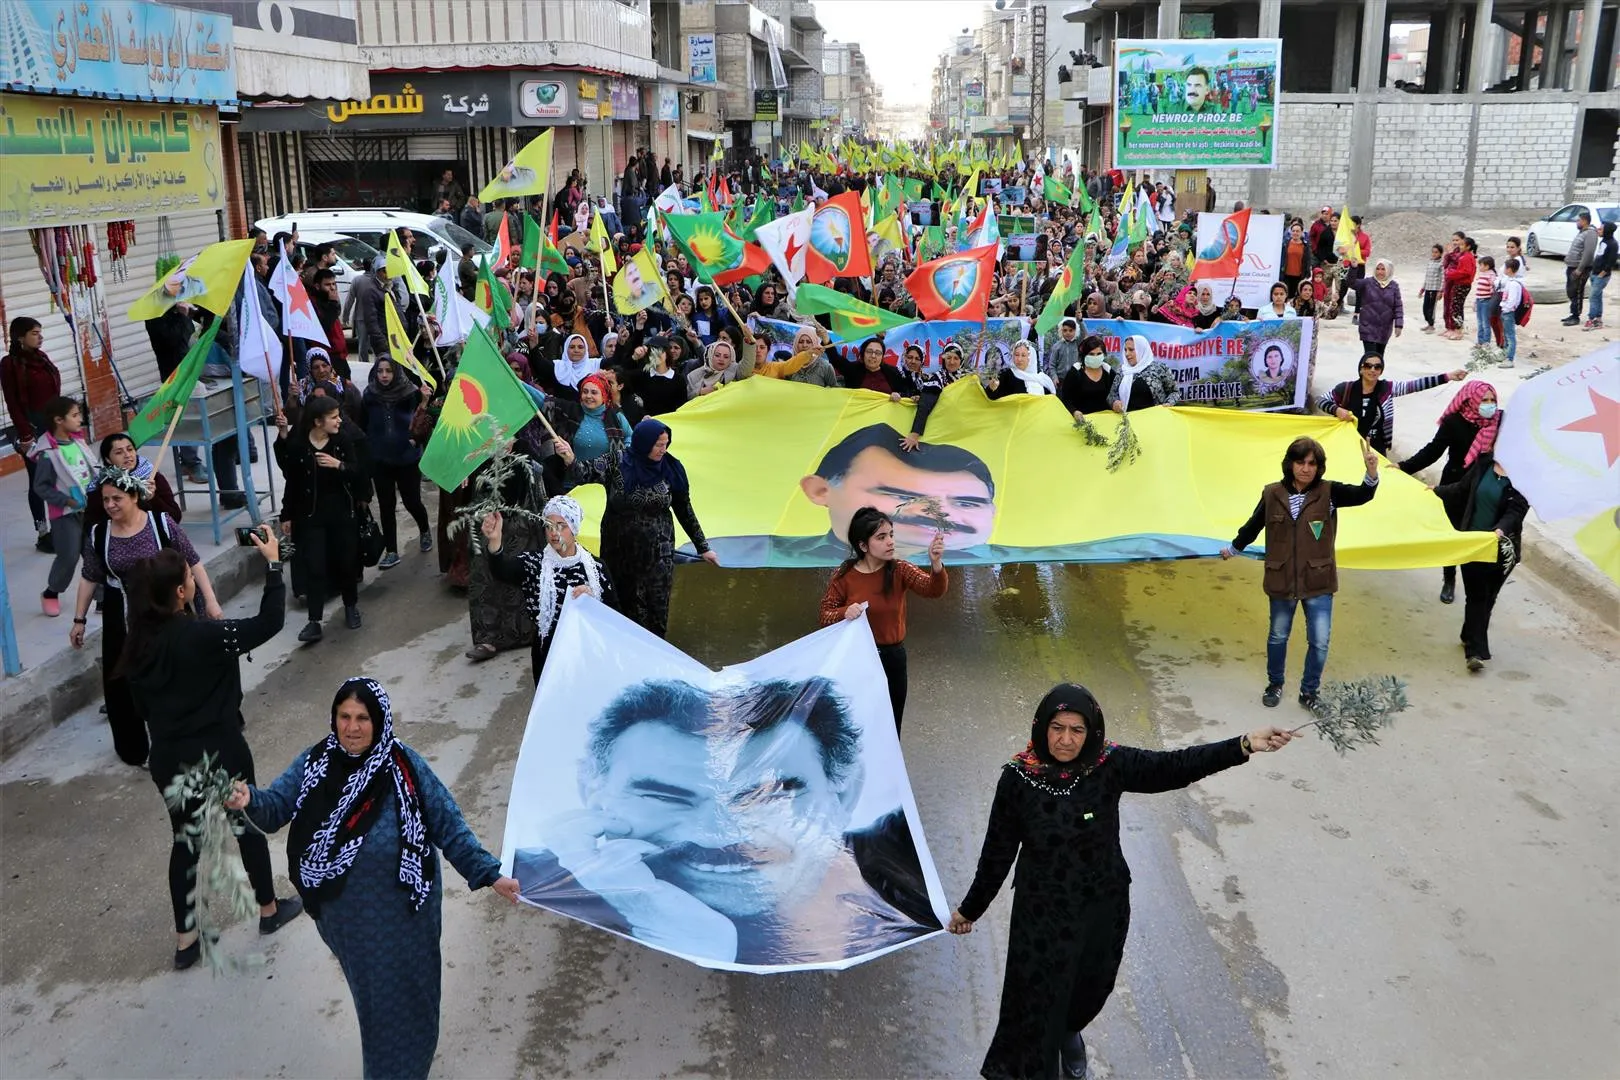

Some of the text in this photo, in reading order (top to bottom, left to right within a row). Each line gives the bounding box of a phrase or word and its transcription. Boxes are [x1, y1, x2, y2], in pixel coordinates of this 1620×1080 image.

[186, 21, 230, 84] مكتب
[327, 82, 489, 124] شركة شمس
[1152, 113, 1195, 123] NEWROZ
[1229, 113, 1243, 123] BE
[101, 107, 191, 164] كاميران
[1103, 336, 1122, 353] NA
[1226, 338, 1245, 355] RE
